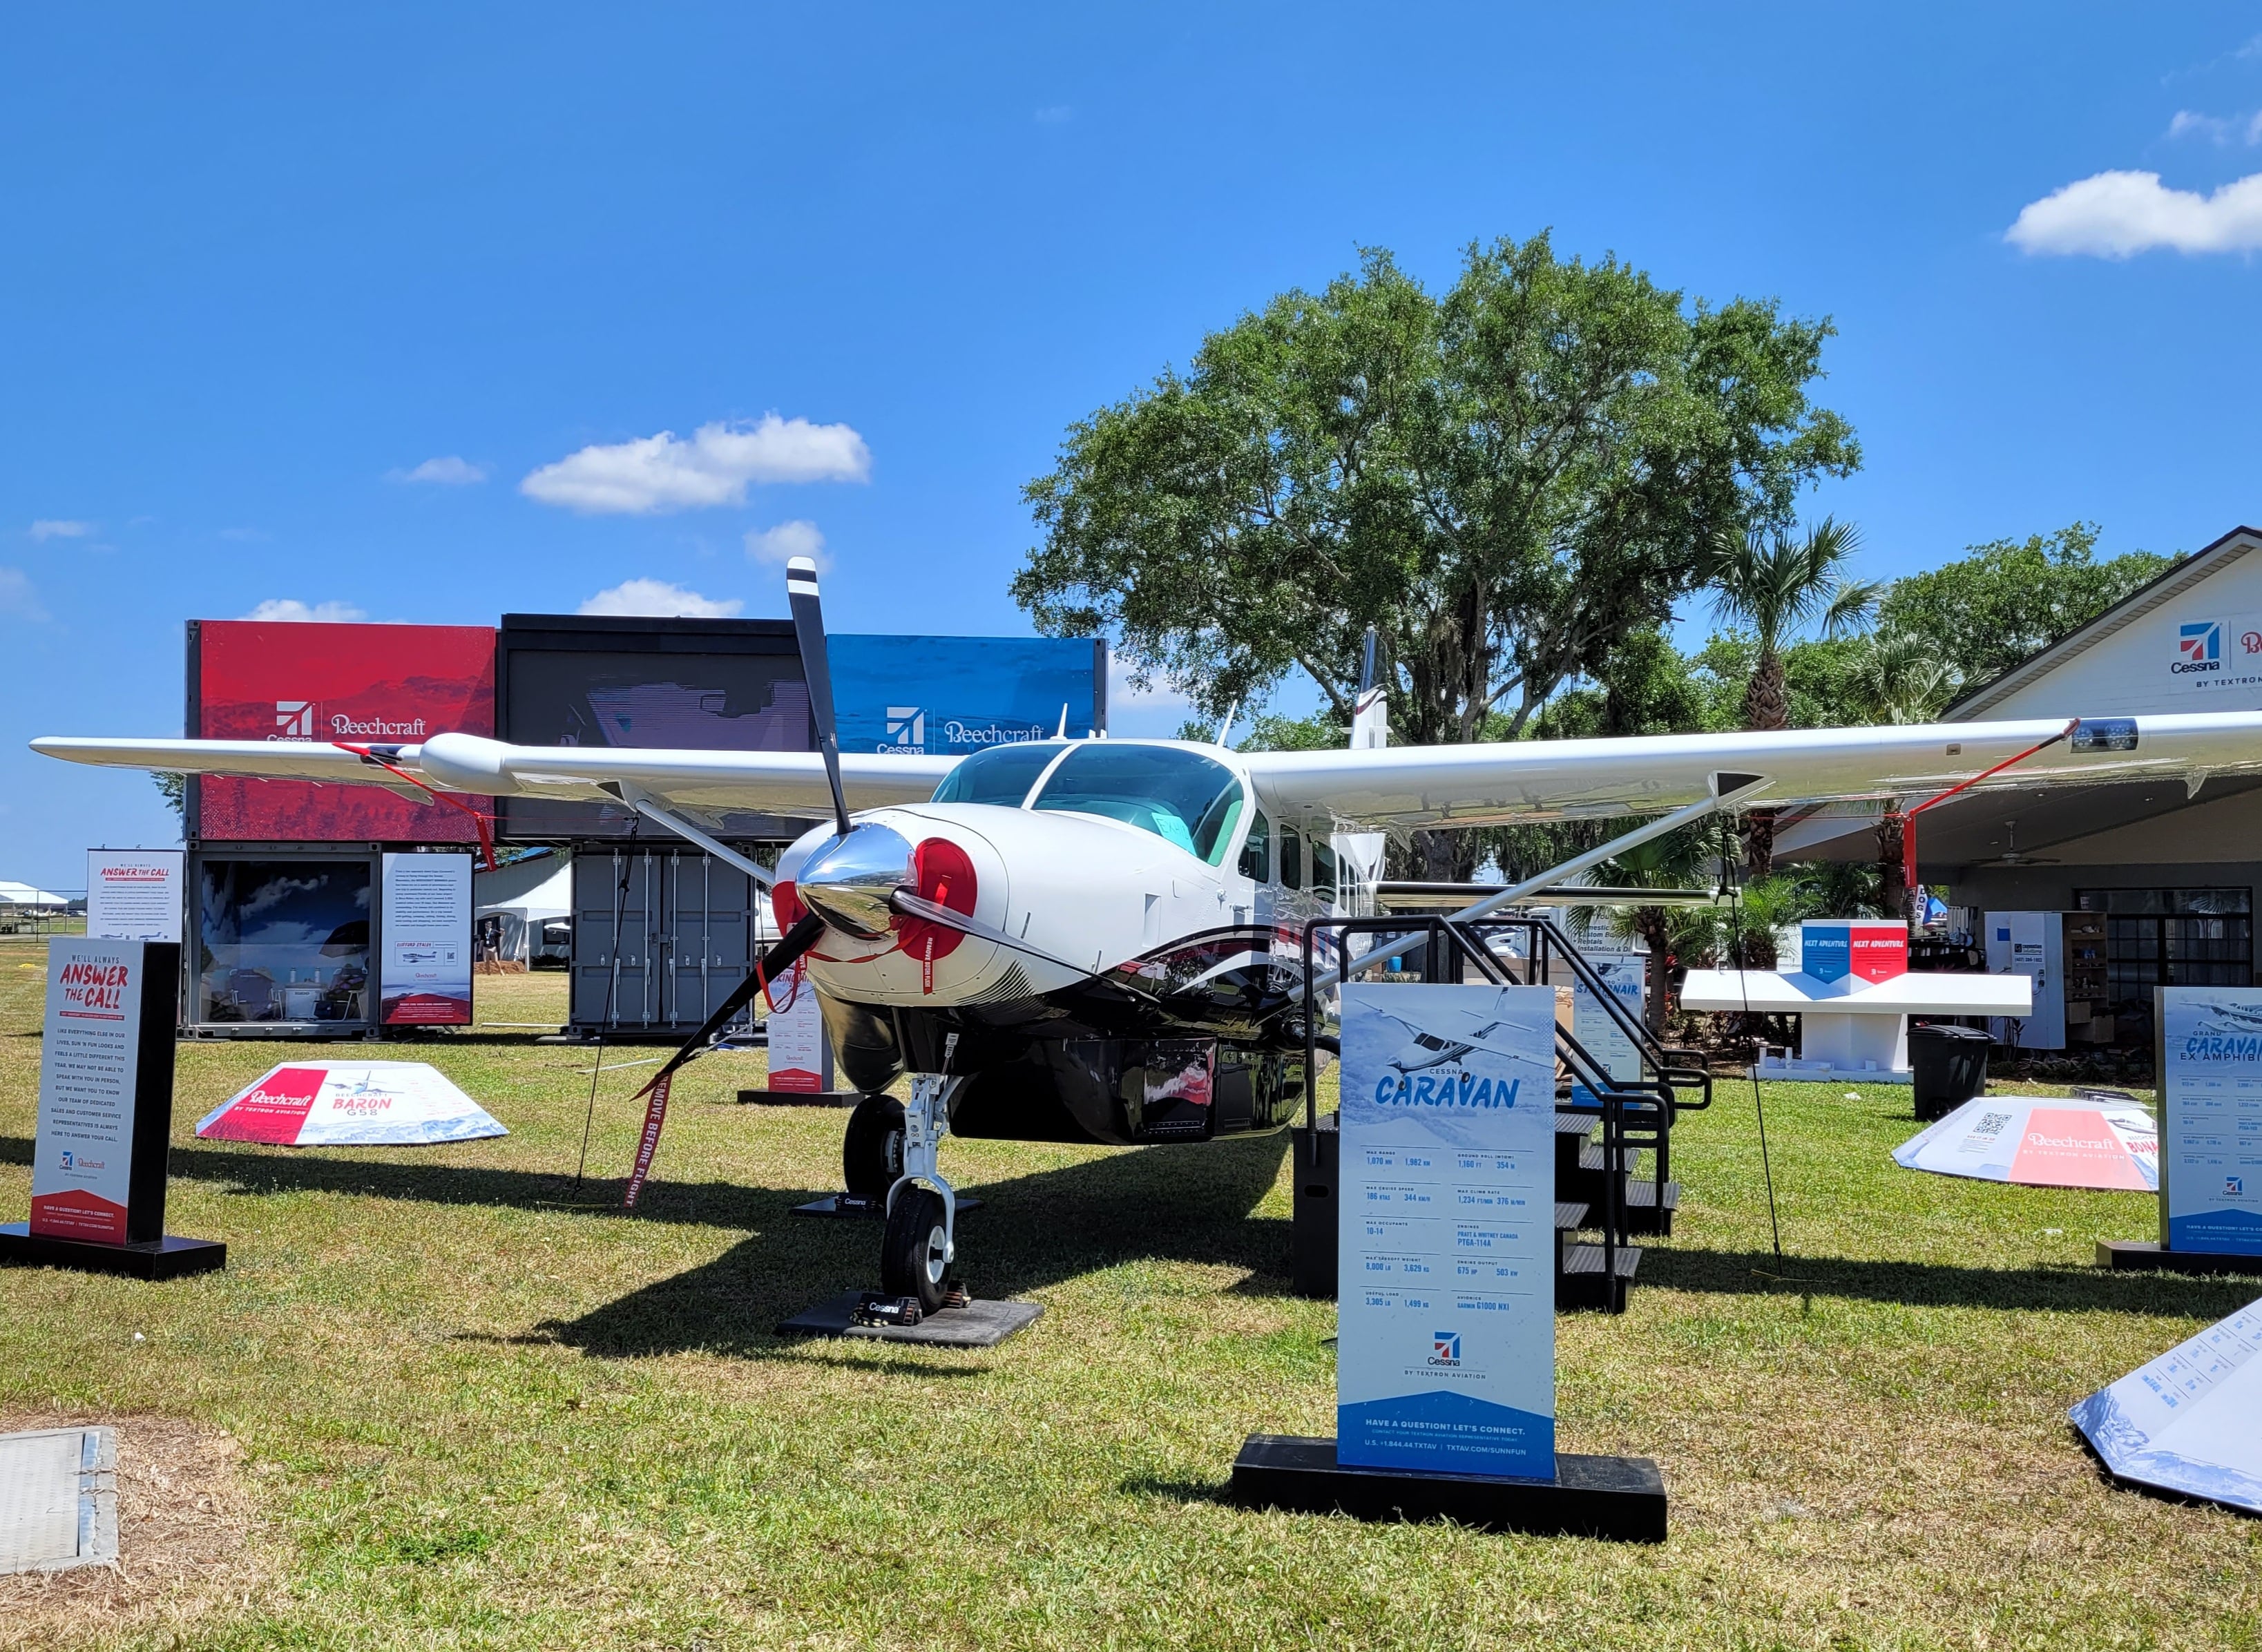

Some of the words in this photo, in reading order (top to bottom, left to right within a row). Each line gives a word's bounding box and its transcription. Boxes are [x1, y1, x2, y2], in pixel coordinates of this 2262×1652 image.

[2171, 661, 2220, 674] Cessna
[332, 714, 425, 736] Beechcraft
[945, 721, 1044, 743] Beechcraft
[267, 734, 312, 742] Cessna
[877, 743, 924, 754] Cessna
[100, 867, 137, 876] ANSWER
[151, 868, 170, 876] CALL
[924, 937, 933, 961] REMOVE
[1819, 939, 1848, 948] ADVENTURE
[1870, 940, 1904, 948] ADVENTURE
[59, 963, 128, 987] ANSWER
[65, 988, 84, 1001] THE
[84, 987, 121, 1009] CALL
[2180, 1053, 2196, 1061] EX
[2202, 1053, 2261, 1062] AMPHIBI
[1375, 1075, 1520, 1109] CARAVAN
[249, 1090, 312, 1106] Beechcraft
[332, 1097, 392, 1109] BARON
[650, 1075, 669, 1121] REMOVE
[52, 1119, 93, 1128] REPRESENTATIVES
[638, 1122, 659, 1166] BEFORE
[2028, 1133, 2115, 1150] Beechcraft
[2126, 1141, 2158, 1153] BONA
[1368, 1157, 1383, 1165] 1,070
[1459, 1160, 1474, 1169] 1,160
[626, 1167, 646, 1207] FLIGHT
[1459, 1195, 1475, 1204] 1,234
[1457, 1238, 1491, 1247] PT6A-114A
[1366, 1262, 1383, 1271] 8,000
[1403, 1265, 1421, 1273] 3,629
[1496, 1268, 1508, 1276] 503
[869, 1302, 899, 1314] Cessna
[1365, 1298, 1383, 1306] 3,305
[1404, 1299, 1421, 1307] 1,499
[1477, 1302, 1496, 1310] G1000
[1428, 1356, 1460, 1366] Cessna
[1401, 1421, 1450, 1430] QUESTION?
[1479, 1426, 1526, 1435] CONNECT.
[1447, 1444, 1526, 1455] TXTAV.COM/SUNNFUN
